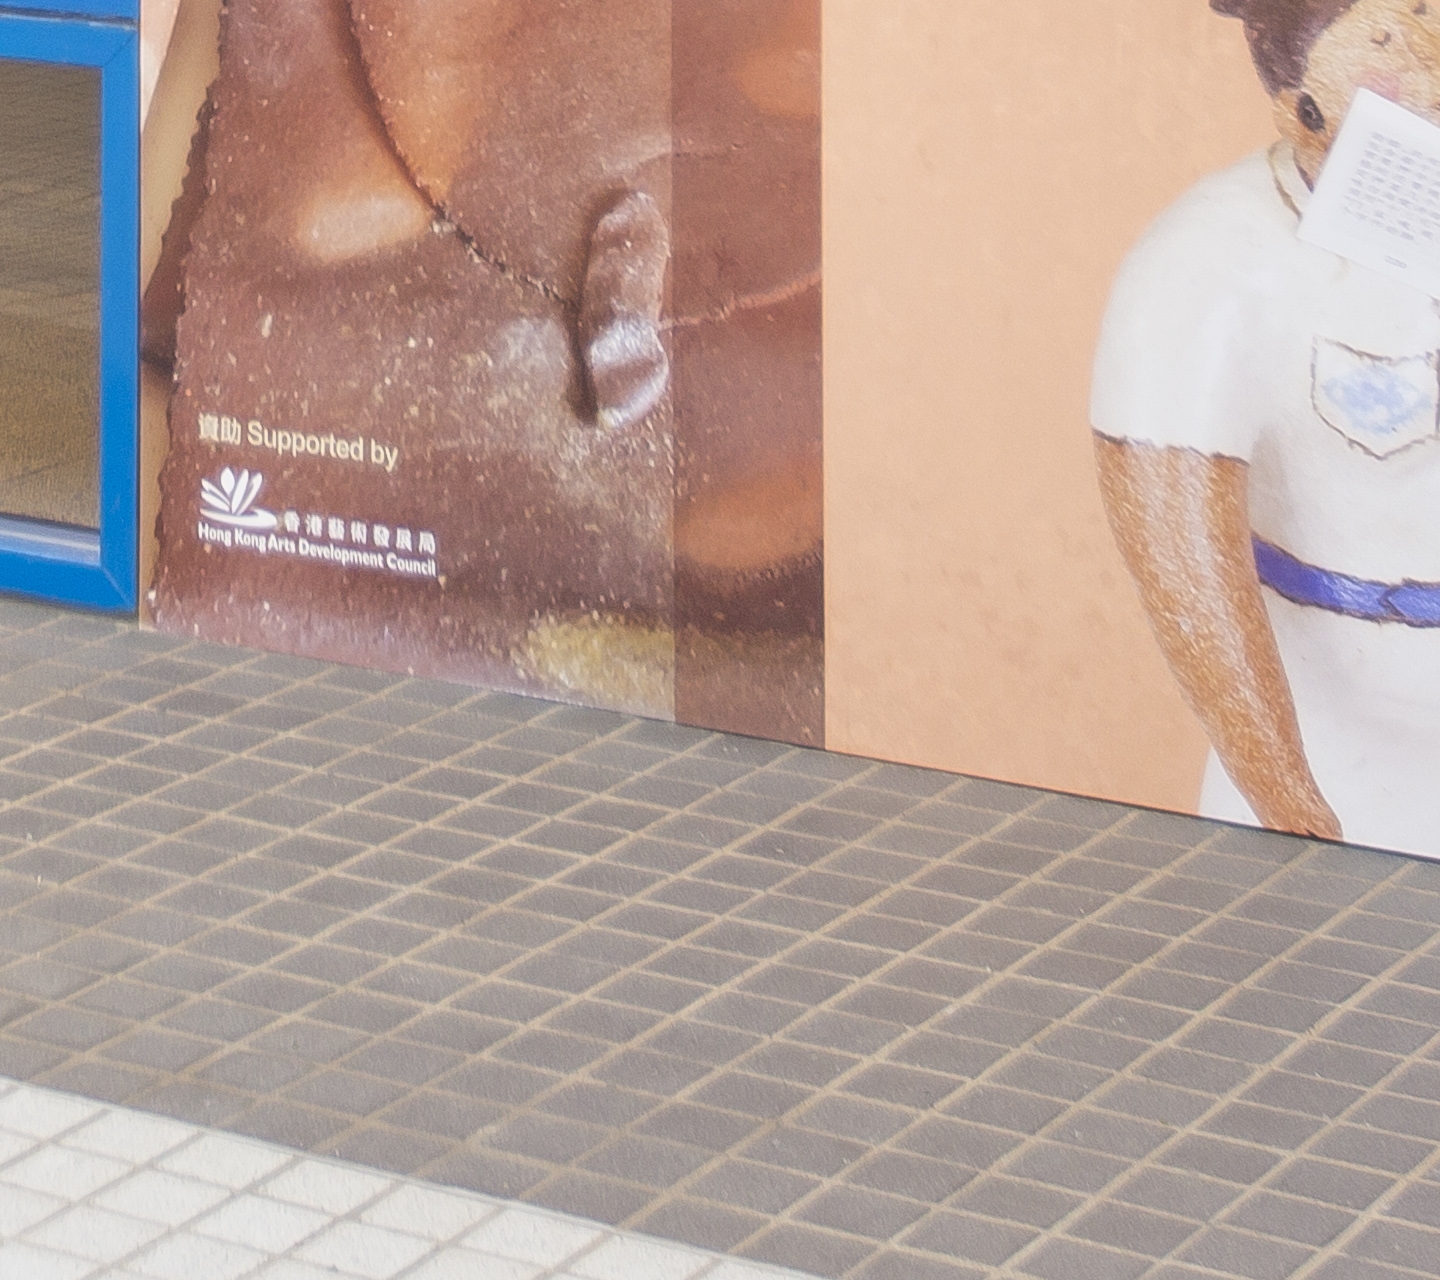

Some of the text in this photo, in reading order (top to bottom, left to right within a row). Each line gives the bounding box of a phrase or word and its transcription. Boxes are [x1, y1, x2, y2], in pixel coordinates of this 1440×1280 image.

[199, 415, 398, 472] 資助 Supported by
[198, 519, 436, 577] Hong Kong Arts Development Council
